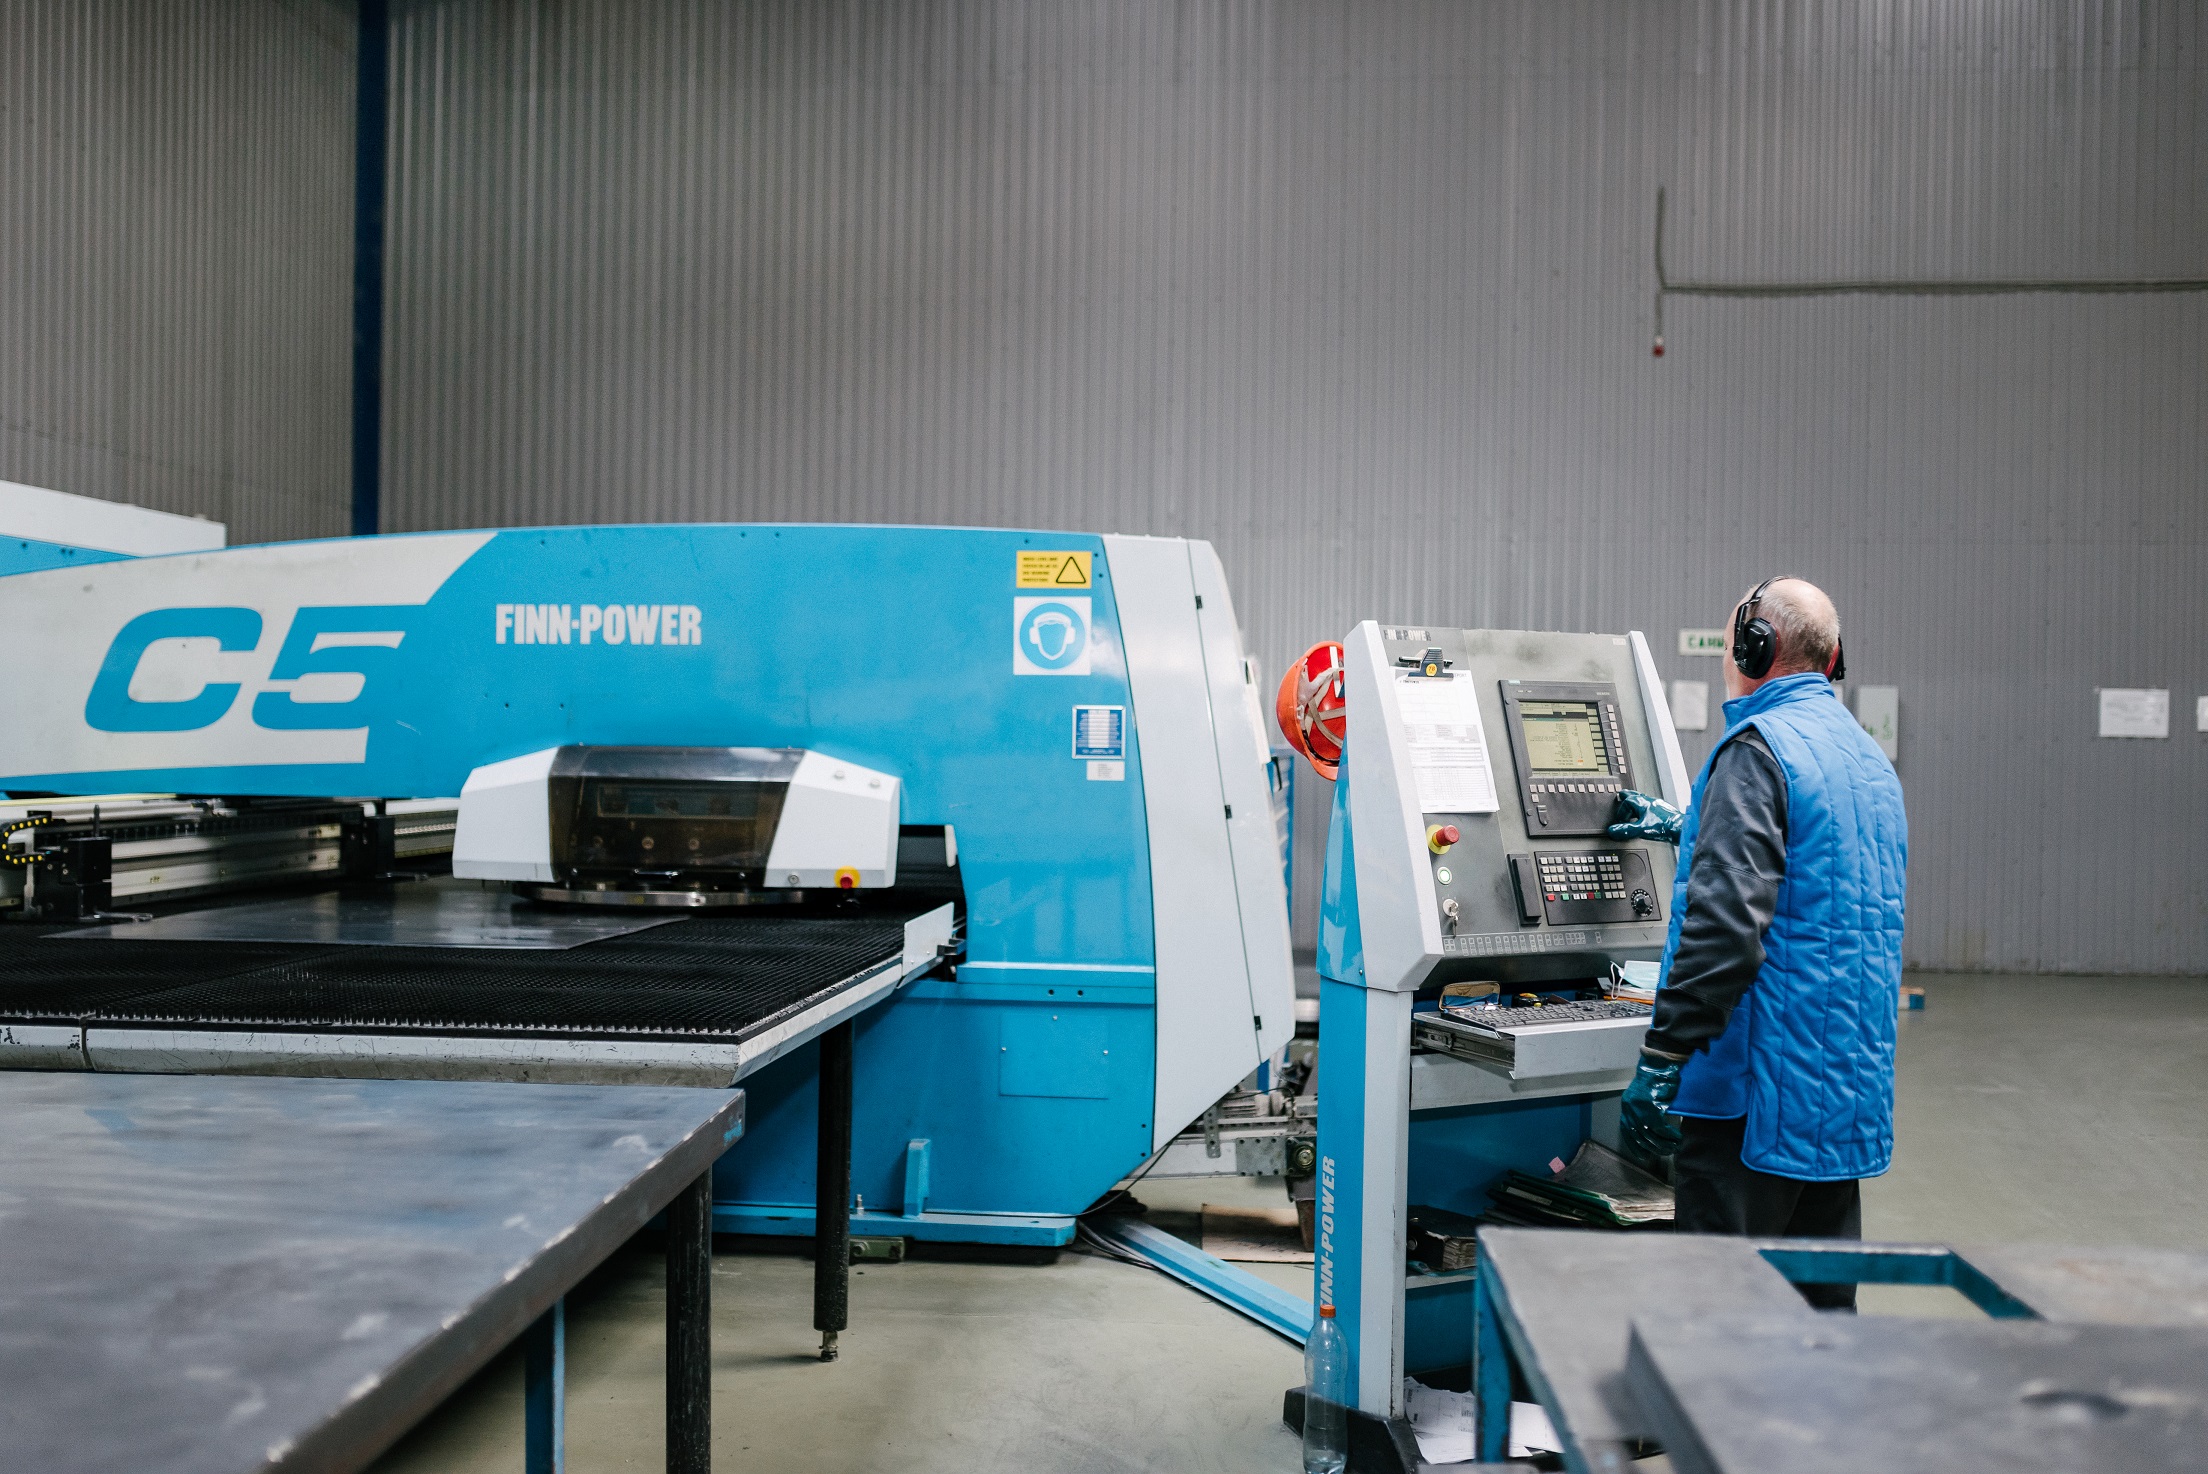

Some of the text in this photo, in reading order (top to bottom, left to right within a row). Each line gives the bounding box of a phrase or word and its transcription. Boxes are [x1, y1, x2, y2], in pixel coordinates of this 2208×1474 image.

[496, 604, 703, 646] FINN-POWER
[1383, 629, 1431, 641] FINN-POWER
[85, 603, 408, 732] C5
